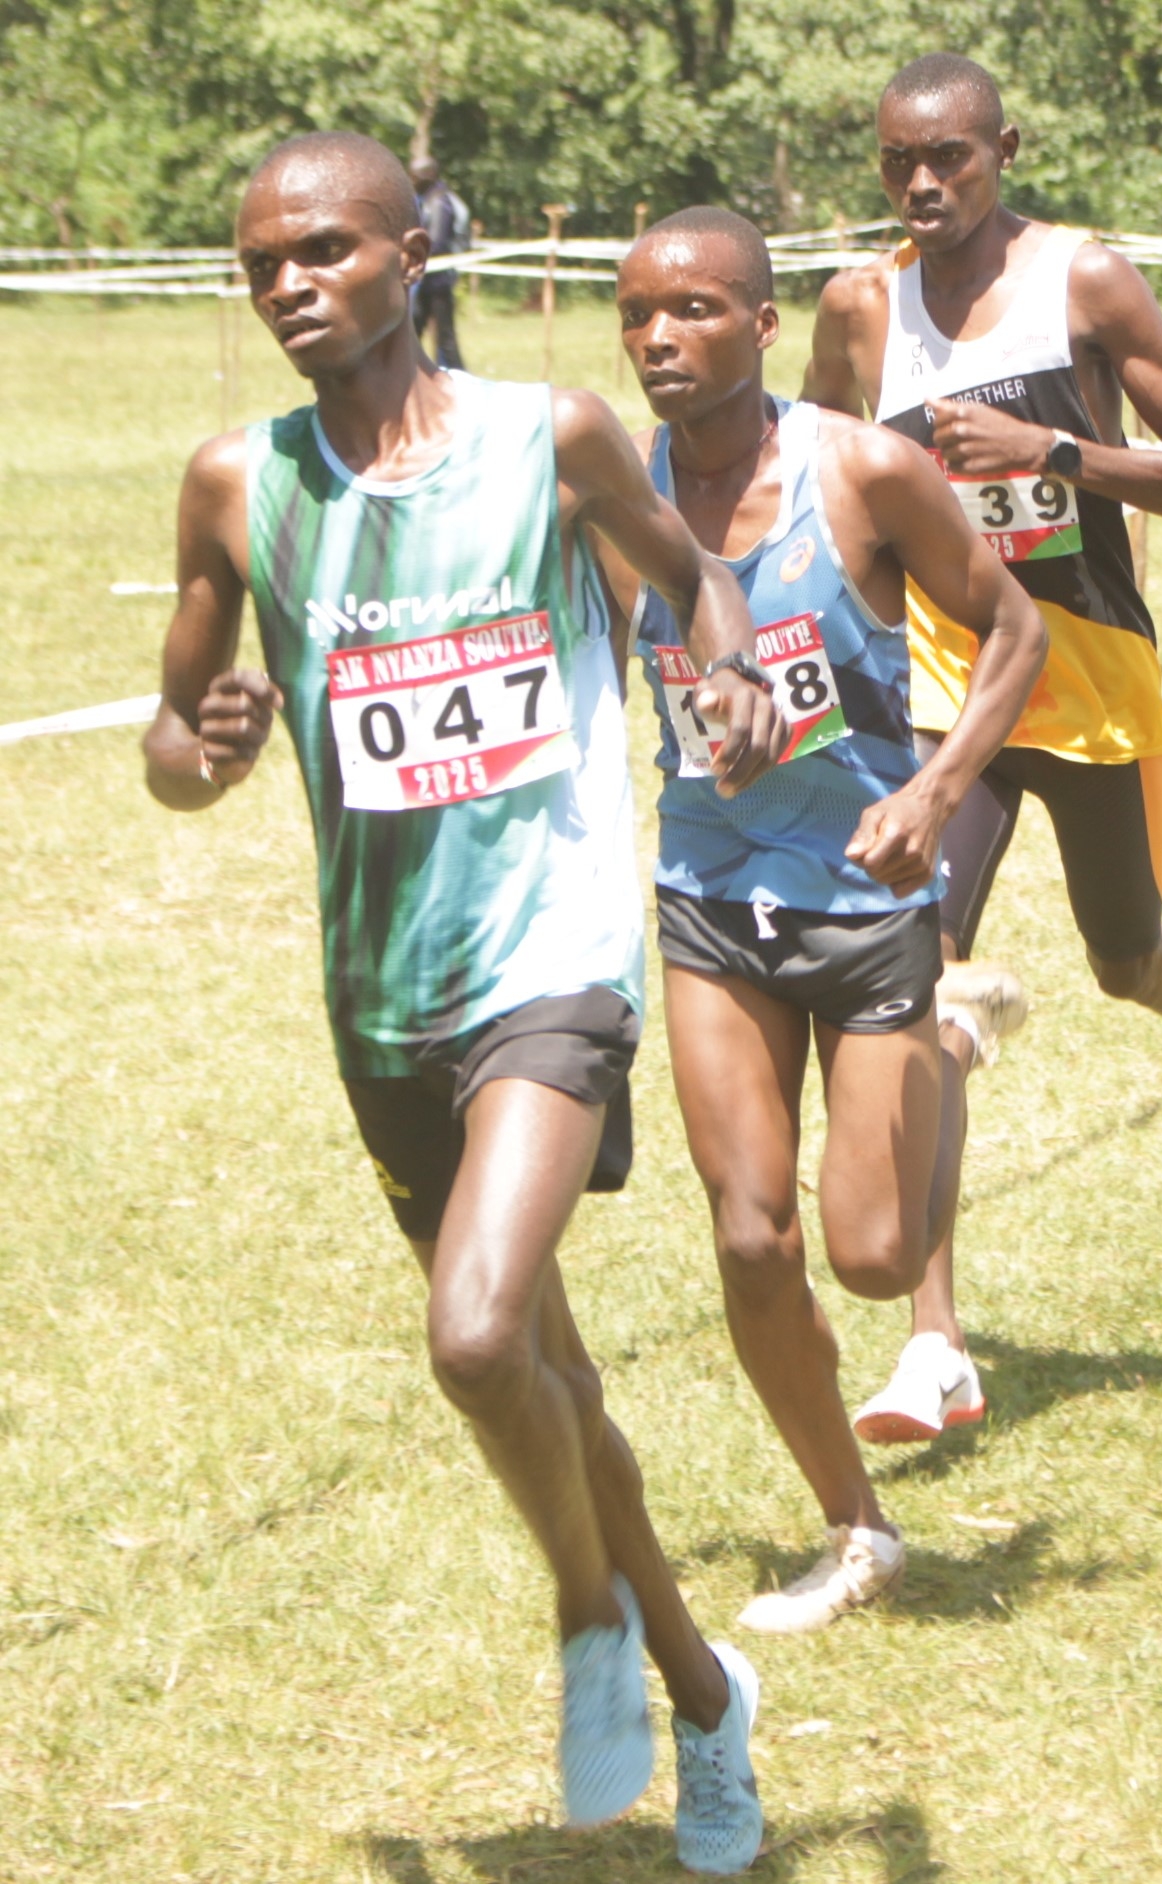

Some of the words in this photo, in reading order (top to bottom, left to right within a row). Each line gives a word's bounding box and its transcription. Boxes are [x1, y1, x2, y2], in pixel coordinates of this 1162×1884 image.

[978, 479, 1068, 528] 39
[370, 638, 462, 686] NYANZA
[464, 618, 543, 666] SOUTH
[359, 665, 547, 762] 047
[680, 661, 828, 737] 18
[413, 756, 488, 801] 2025
